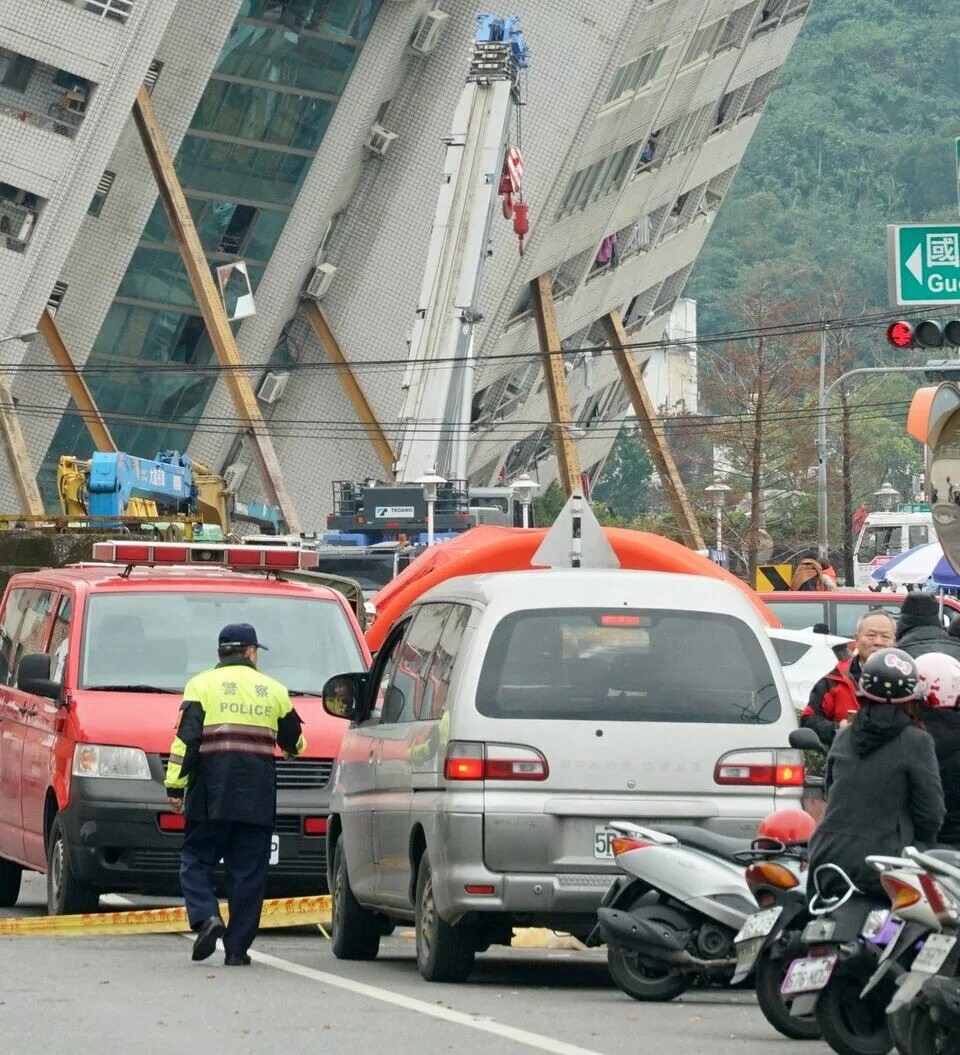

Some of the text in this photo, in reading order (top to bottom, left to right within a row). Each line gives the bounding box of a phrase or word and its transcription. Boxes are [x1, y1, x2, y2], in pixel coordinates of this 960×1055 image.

[926, 233, 960, 268] 國
[927, 273, 960, 293] Gu
[220, 702, 272, 717] POLICE
